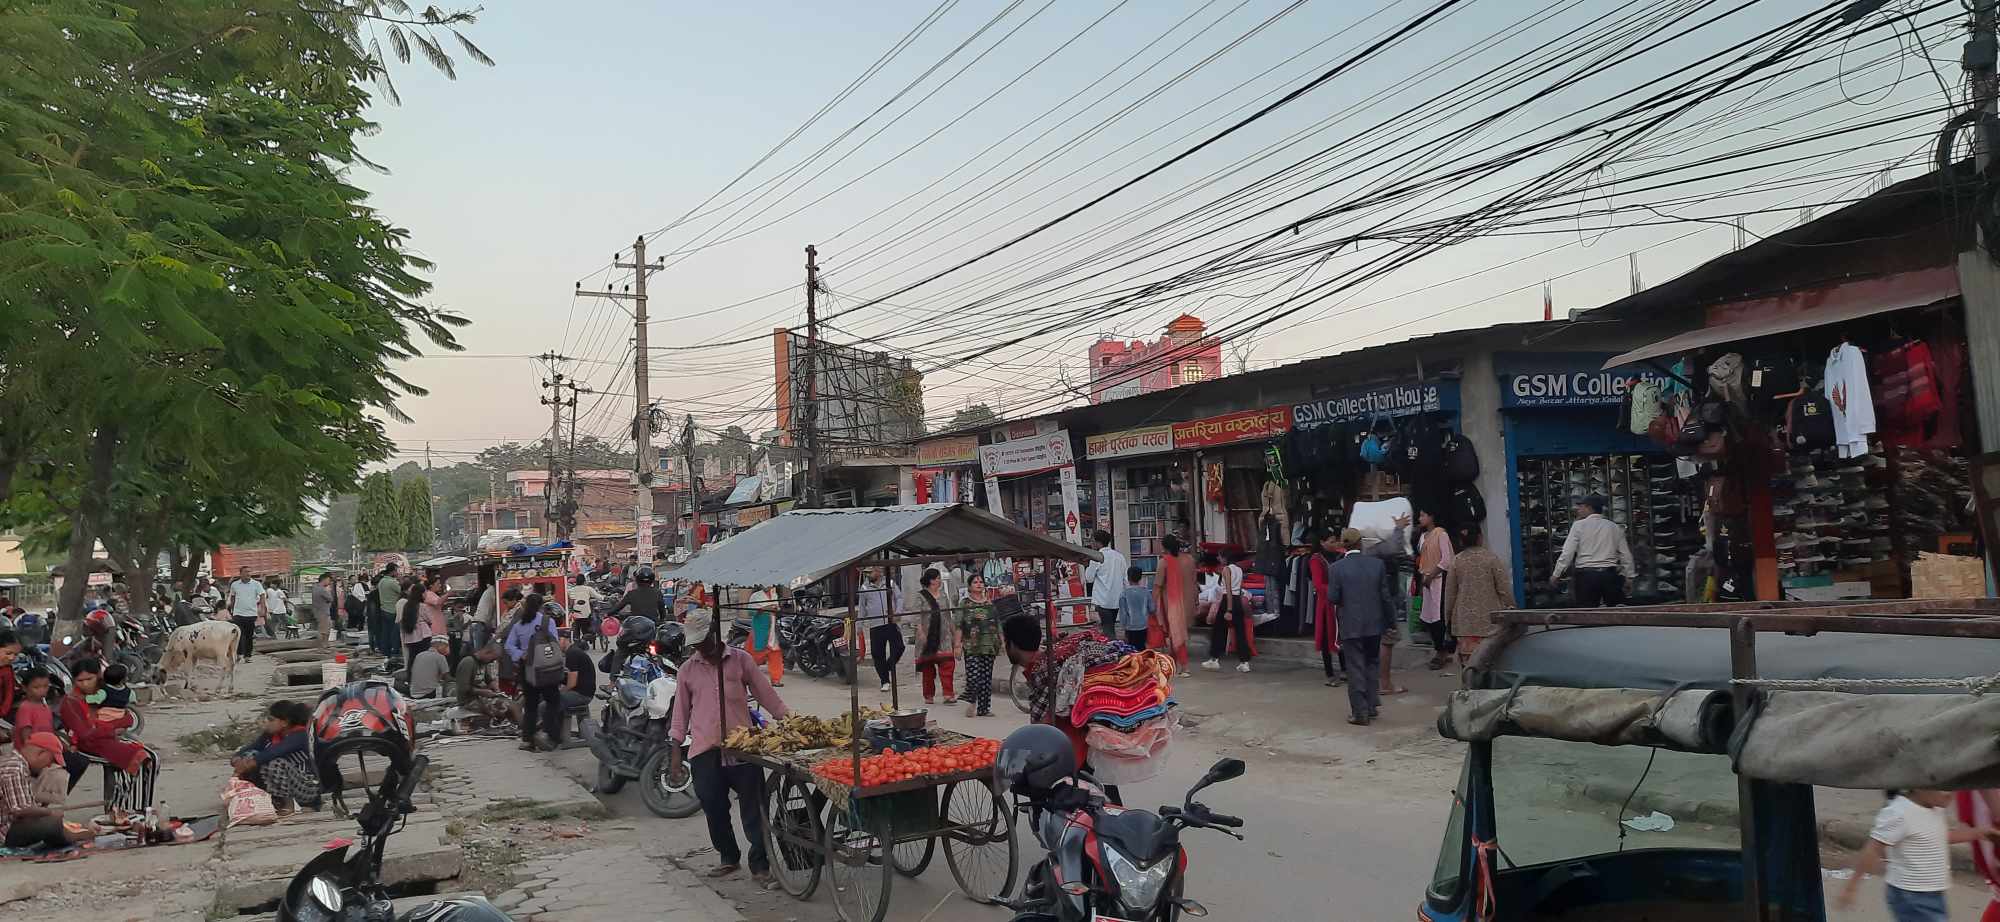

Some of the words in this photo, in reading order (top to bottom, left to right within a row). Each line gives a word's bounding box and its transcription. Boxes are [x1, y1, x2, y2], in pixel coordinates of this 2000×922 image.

[1513, 374, 1567, 397] GSM
[1293, 403, 1326, 423] GSM
[1327, 392, 1395, 417] Collection
[1395, 386, 1437, 407] House
[1109, 435, 1138, 454] पुस्तक
[1142, 431, 1169, 447] पसल
